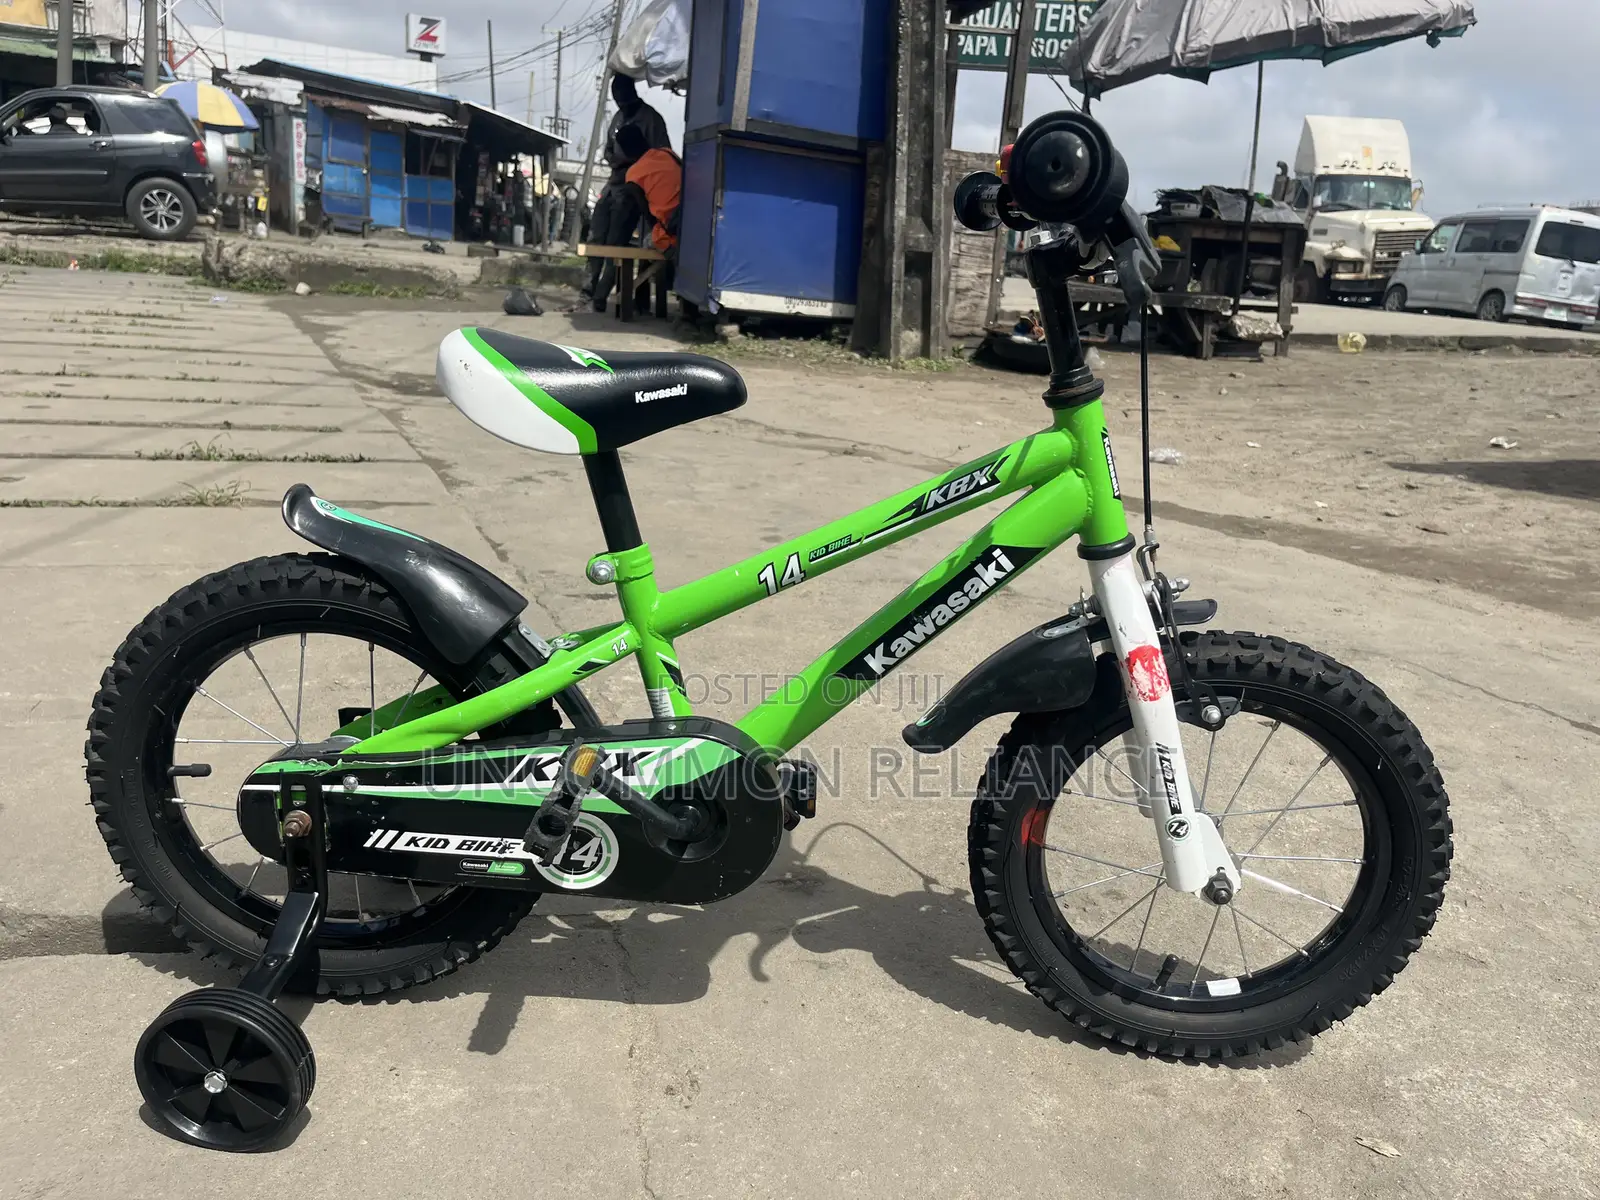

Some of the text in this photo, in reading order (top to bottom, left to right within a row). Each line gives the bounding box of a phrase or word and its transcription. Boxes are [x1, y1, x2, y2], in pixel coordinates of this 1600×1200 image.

[635, 383, 688, 403] Kawasaki
[926, 464, 992, 510] KBX
[1103, 436, 1120, 497] Kawasaki
[757, 535, 852, 597] 14 KID BIKE
[863, 548, 1015, 675] Kawasaki
[612, 638, 628, 656] 14
[1161, 759, 1180, 810] KID BIKE
[404, 836, 451, 849] KID
[1169, 822, 1188, 836] 14
